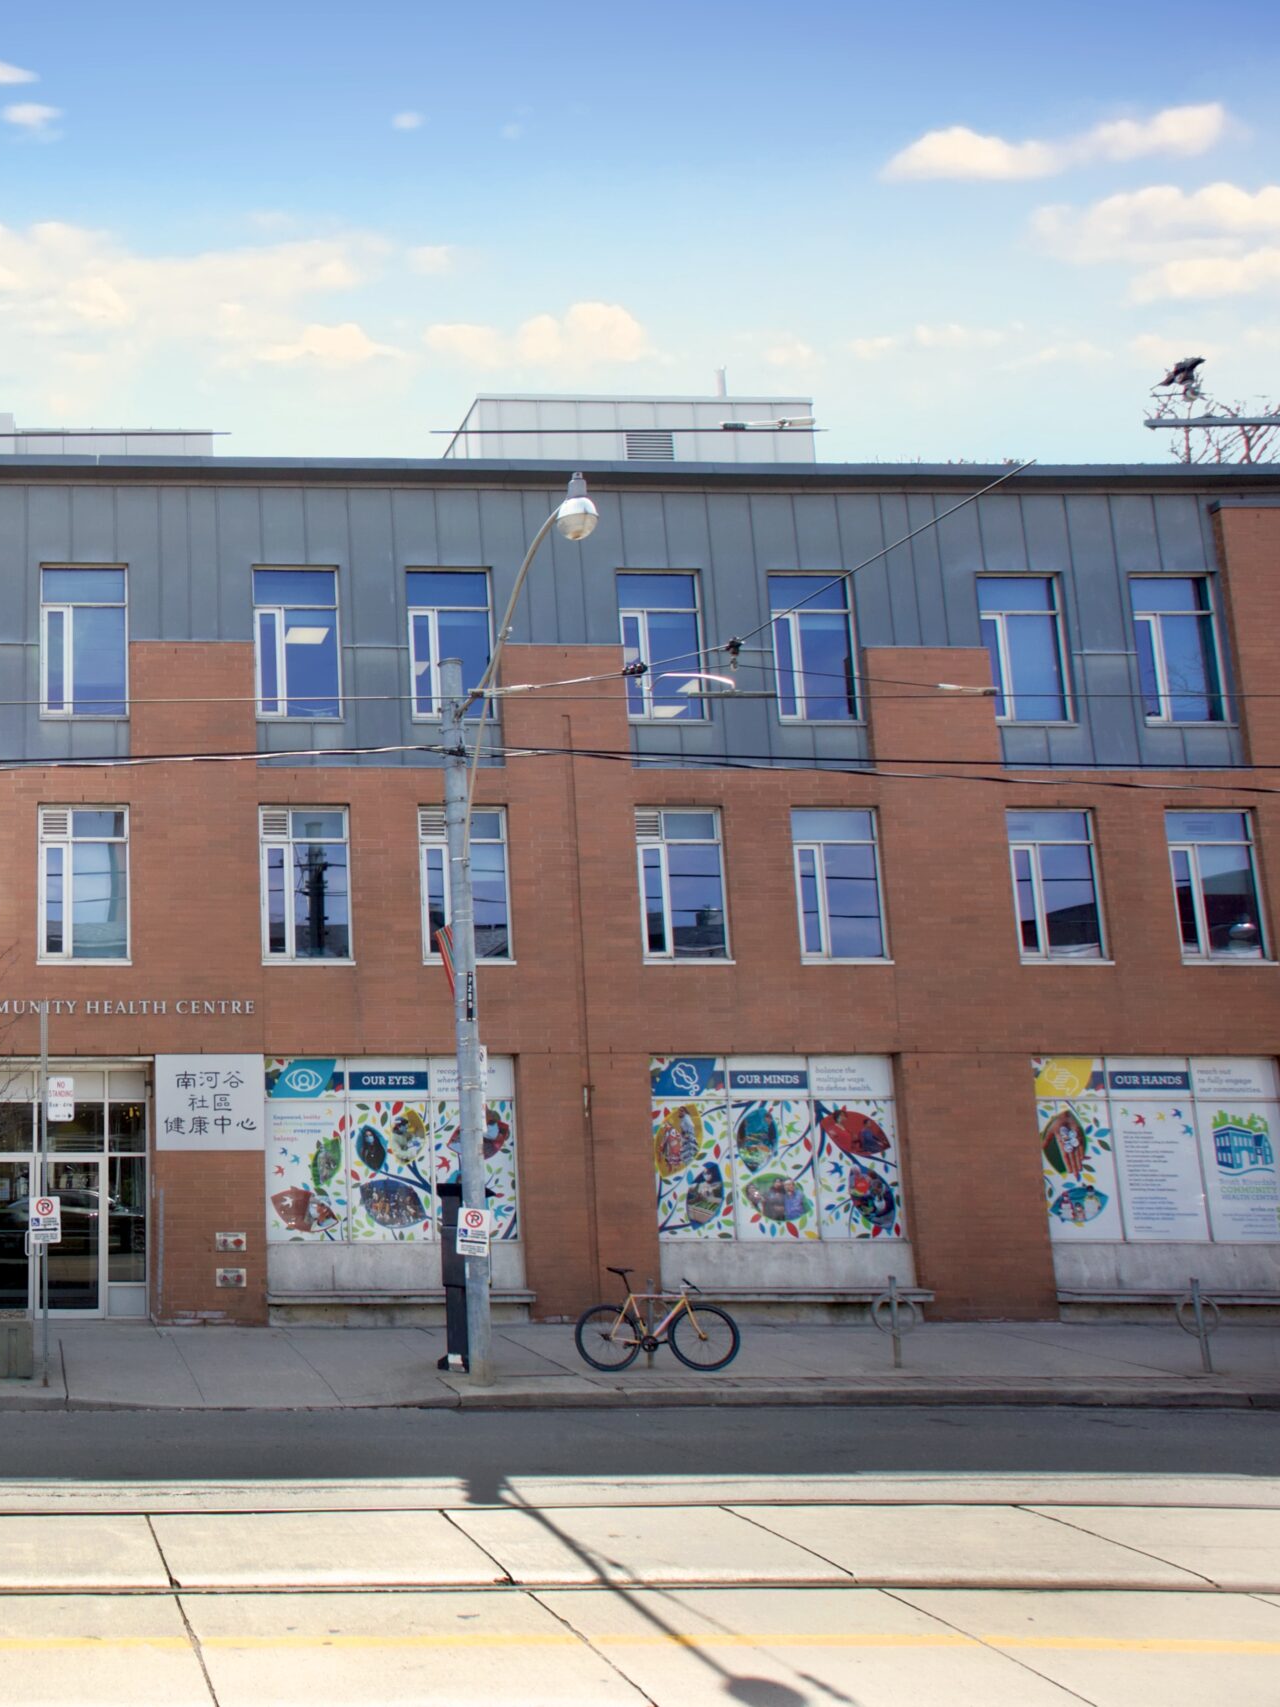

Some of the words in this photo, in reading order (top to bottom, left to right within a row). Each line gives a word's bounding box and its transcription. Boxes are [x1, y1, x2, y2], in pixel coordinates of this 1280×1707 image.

[86, 1000, 167, 1014] HEALTH
[176, 1000, 256, 1014] CENTRE
[175, 1070, 244, 1090] 南河谷
[361, 1075, 386, 1086] OUR
[387, 1075, 415, 1086] EYES
[736, 1074, 761, 1084] OUR
[763, 1074, 800, 1084] MINDS
[1115, 1075, 1140, 1085] OUR
[1142, 1075, 1182, 1085] HANDS
[56, 1080, 66, 1089] NO
[48, 1090, 74, 1098] STANDING
[188, 1093, 232, 1112] 社區
[164, 1115, 257, 1136] 健康中心
[1220, 1186, 1278, 1194] COMMUNITY
